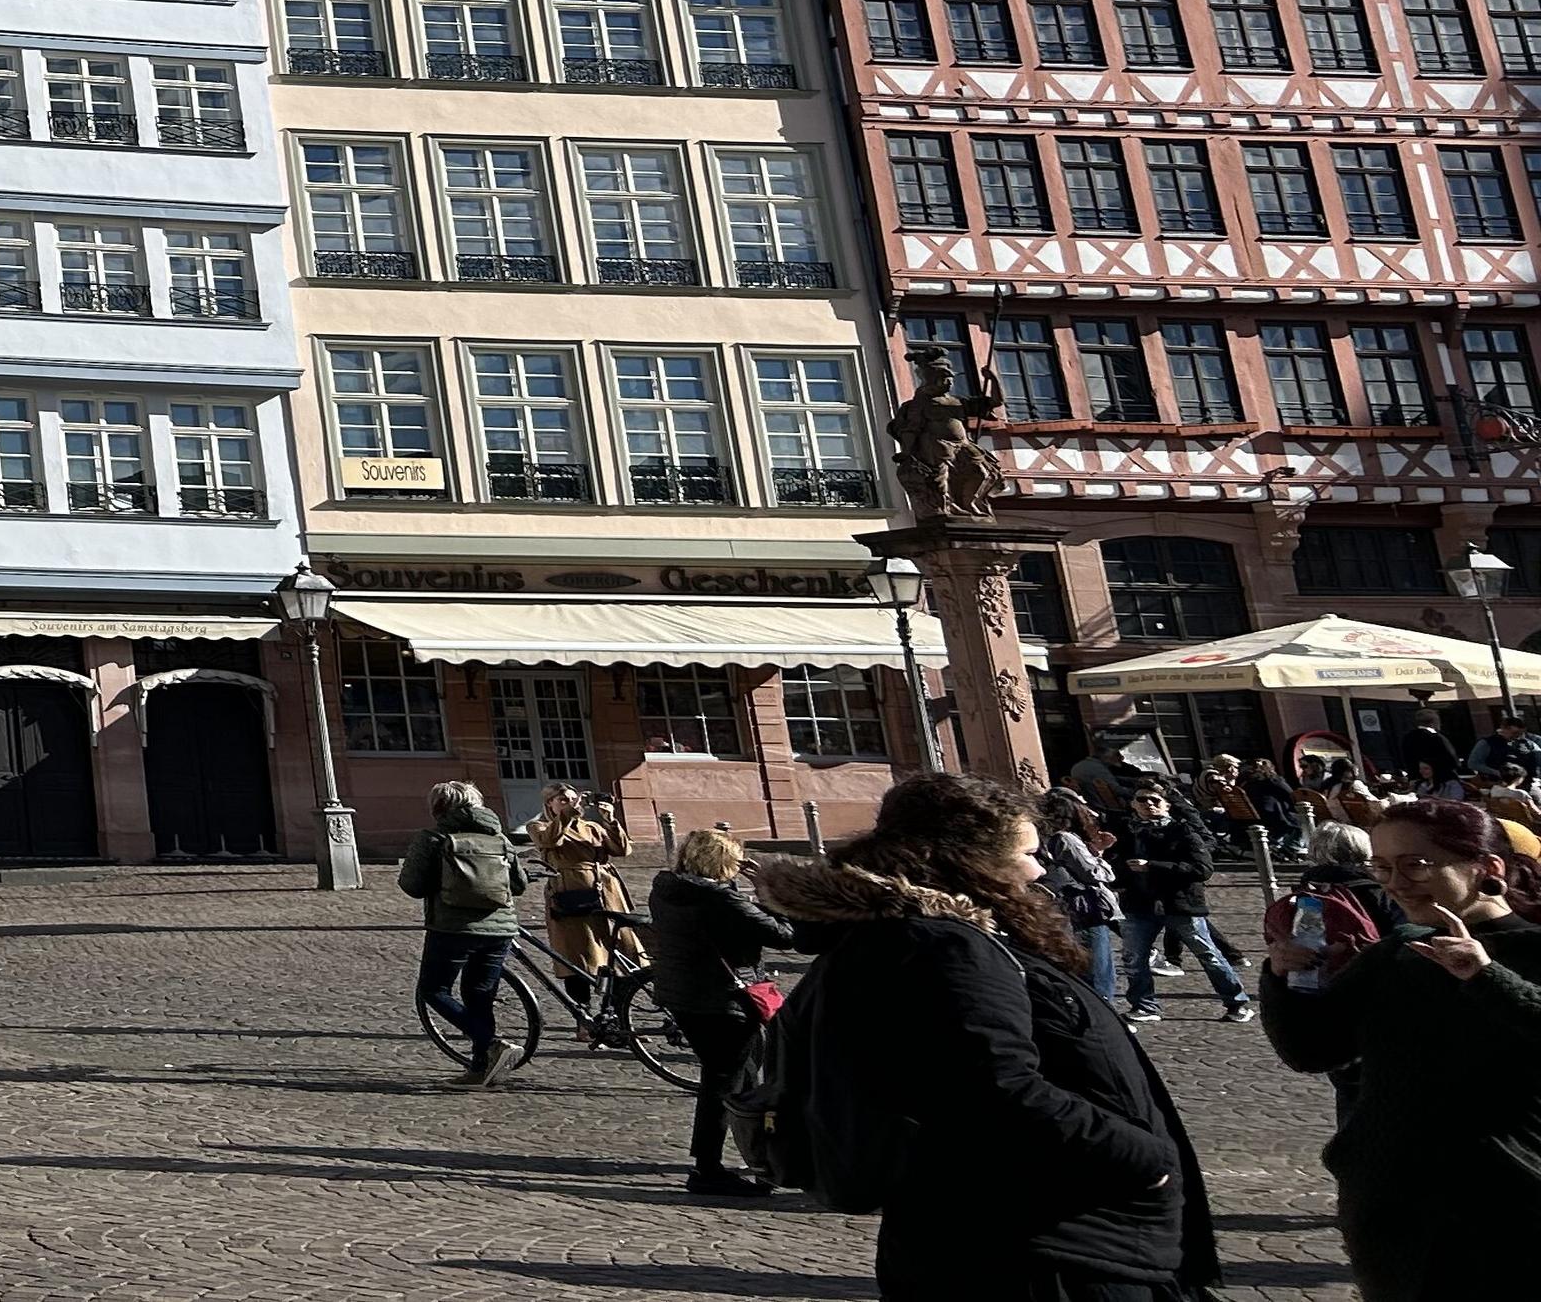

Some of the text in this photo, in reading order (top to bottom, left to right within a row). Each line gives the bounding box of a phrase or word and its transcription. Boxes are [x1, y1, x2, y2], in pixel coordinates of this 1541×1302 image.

[361, 460, 426, 481] Souvenirs
[327, 561, 526, 591] Souvenirs
[30, 620, 207, 635] Souvenirs am Samstagsberg
[1395, 667, 1414, 676] Das
